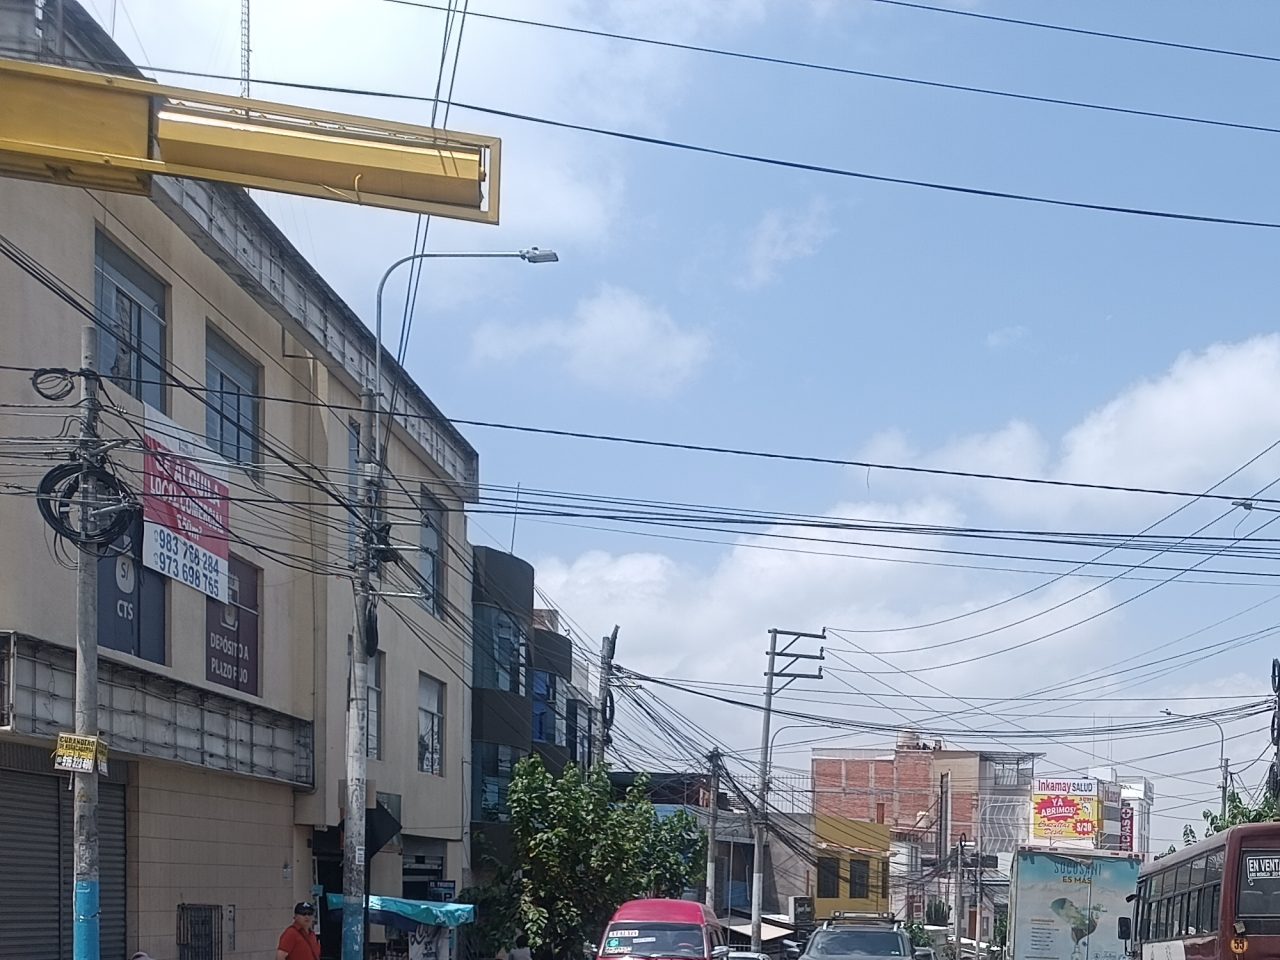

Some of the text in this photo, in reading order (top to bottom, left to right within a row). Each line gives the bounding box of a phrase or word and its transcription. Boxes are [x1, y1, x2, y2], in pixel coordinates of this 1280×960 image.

[174, 459, 220, 507] ALQUILA
[150, 472, 224, 533] LOCAL COMERCIAL
[159, 529, 219, 576] 983 768 284
[159, 552, 219, 597] 973 698 765
[116, 599, 134, 621] CTS
[211, 657, 248, 684] PLAZO FJO
[1038, 779, 1093, 794] Inkamay SALUD
[1052, 798, 1063, 806] YA
[1249, 859, 1259, 872] EN
[1234, 939, 1244, 949] 55
